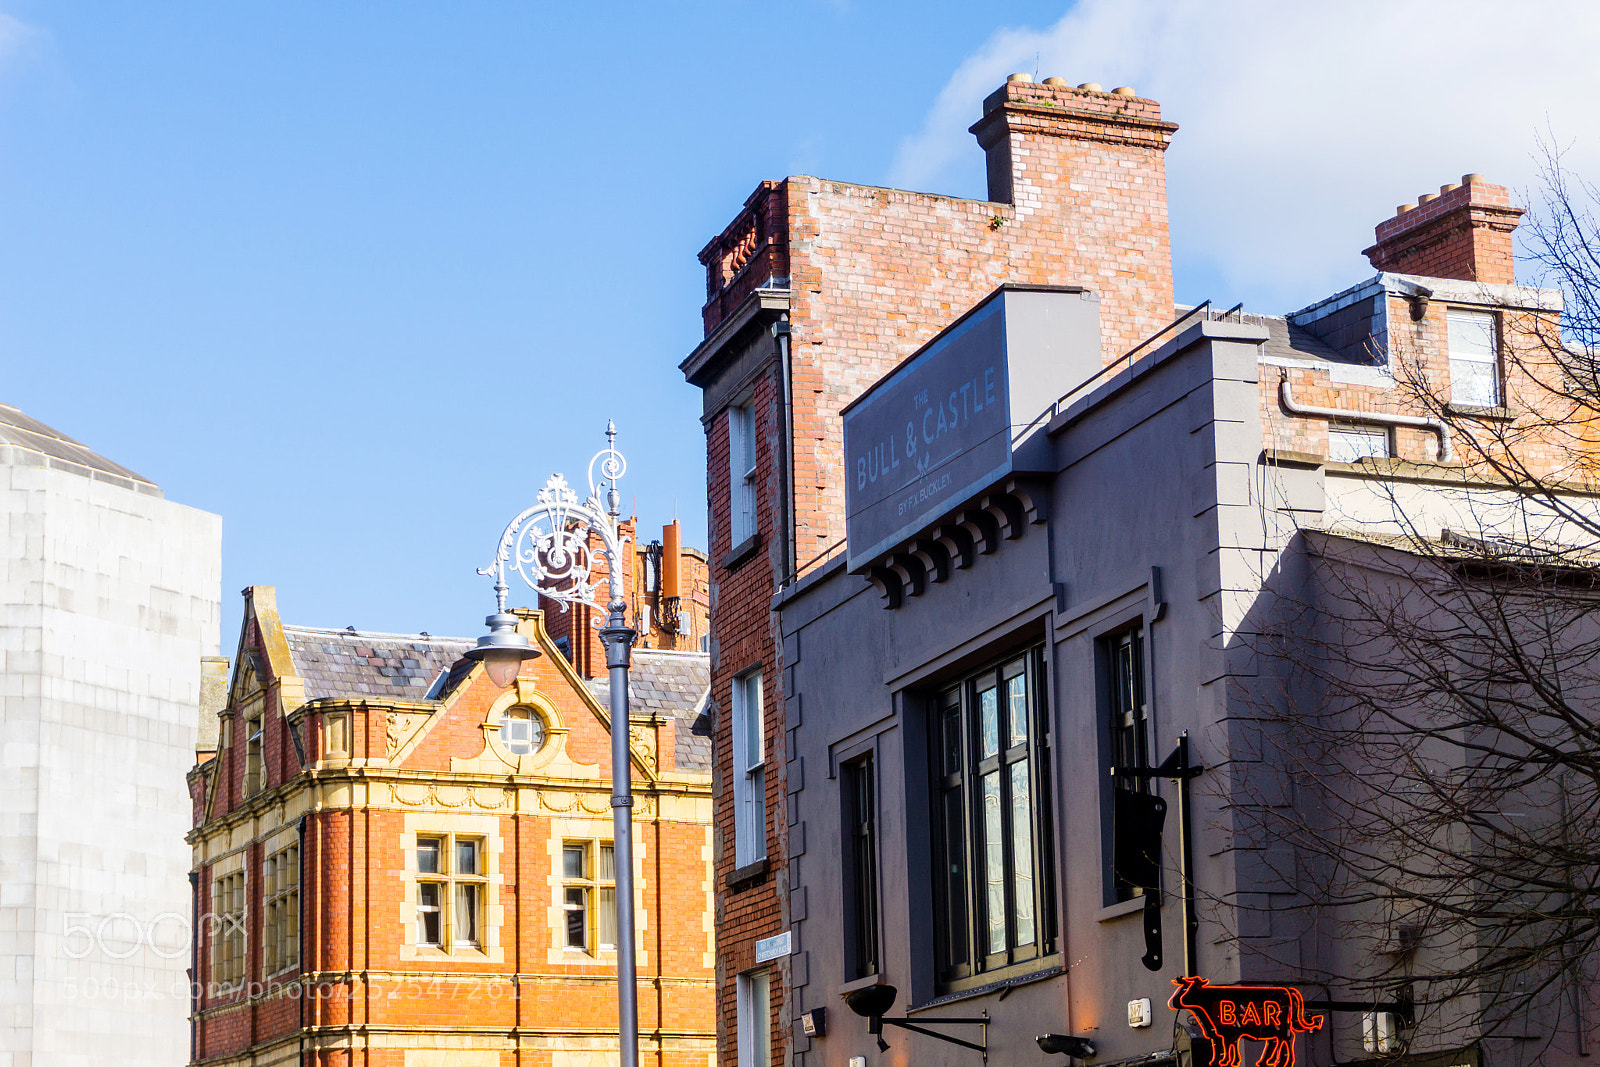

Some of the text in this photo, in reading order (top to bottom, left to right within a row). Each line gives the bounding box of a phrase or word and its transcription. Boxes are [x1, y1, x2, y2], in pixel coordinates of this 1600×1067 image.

[913, 388, 929, 409] THE
[857, 366, 995, 492] BULL & CASTLE
[898, 499, 908, 517] BY
[1219, 1000, 1281, 1026] BAR
